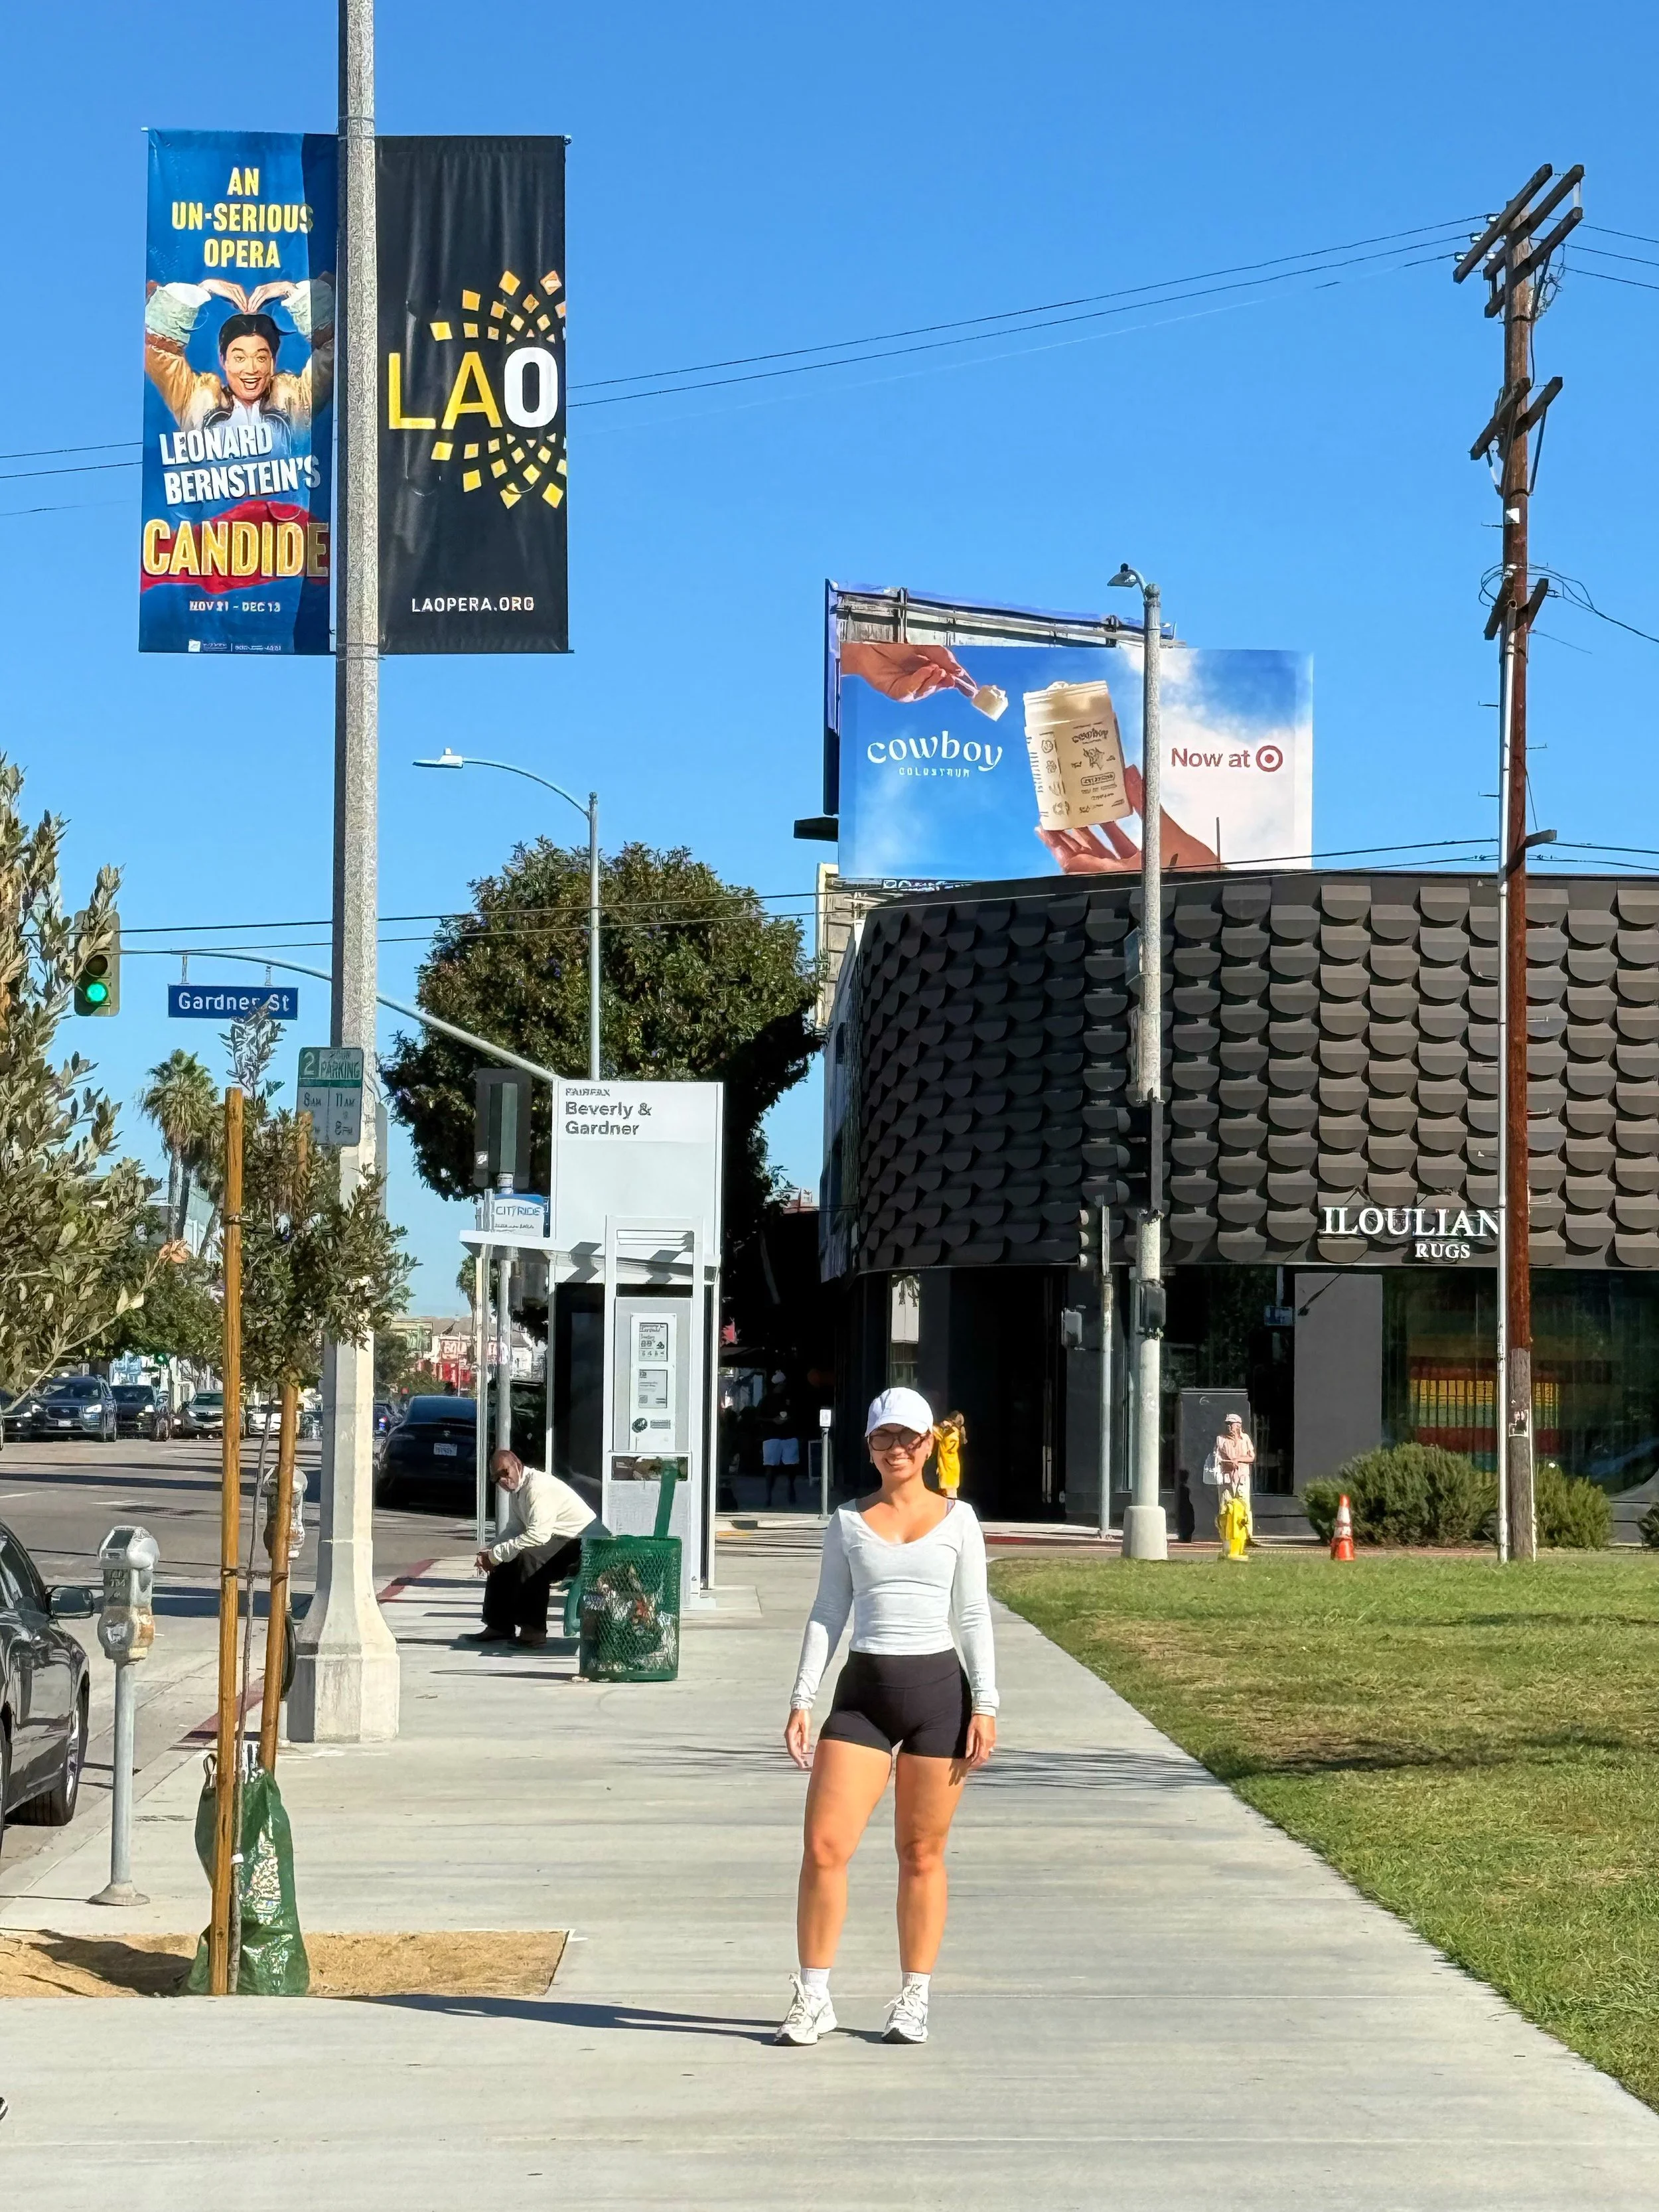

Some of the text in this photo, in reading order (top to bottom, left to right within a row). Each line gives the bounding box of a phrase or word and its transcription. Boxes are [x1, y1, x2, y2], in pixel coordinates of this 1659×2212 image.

[226, 167, 259, 196] AN
[172, 202, 314, 234] UN-SERIOUS
[204, 238, 281, 268] OPERA
[388, 346, 559, 430] LAO
[159, 422, 273, 466] LEONARD
[163, 455, 321, 506] BERNSTEIN'S
[142, 518, 330, 578] CANDIDE
[189, 601, 214, 612] NOV
[242, 601, 265, 613] DEC
[267, 602, 281, 613] 13
[411, 597, 535, 613] LAOPERA.ORG
[867, 730, 1003, 772] cowboy
[1171, 747, 1251, 768] Now at
[899, 767, 970, 778] COLOSTRUM
[178, 992, 290, 1011] Gardner St
[303, 1051, 315, 1076] 2
[321, 1061, 361, 1079] PARKING
[565, 1088, 611, 1096] FAIRFAX
[565, 1101, 652, 1120] Beverly &
[565, 1120, 640, 1136] Gardner
[1318, 1206, 1499, 1237] ILOULIAN
[1415, 1242, 1471, 1260] RUGS
